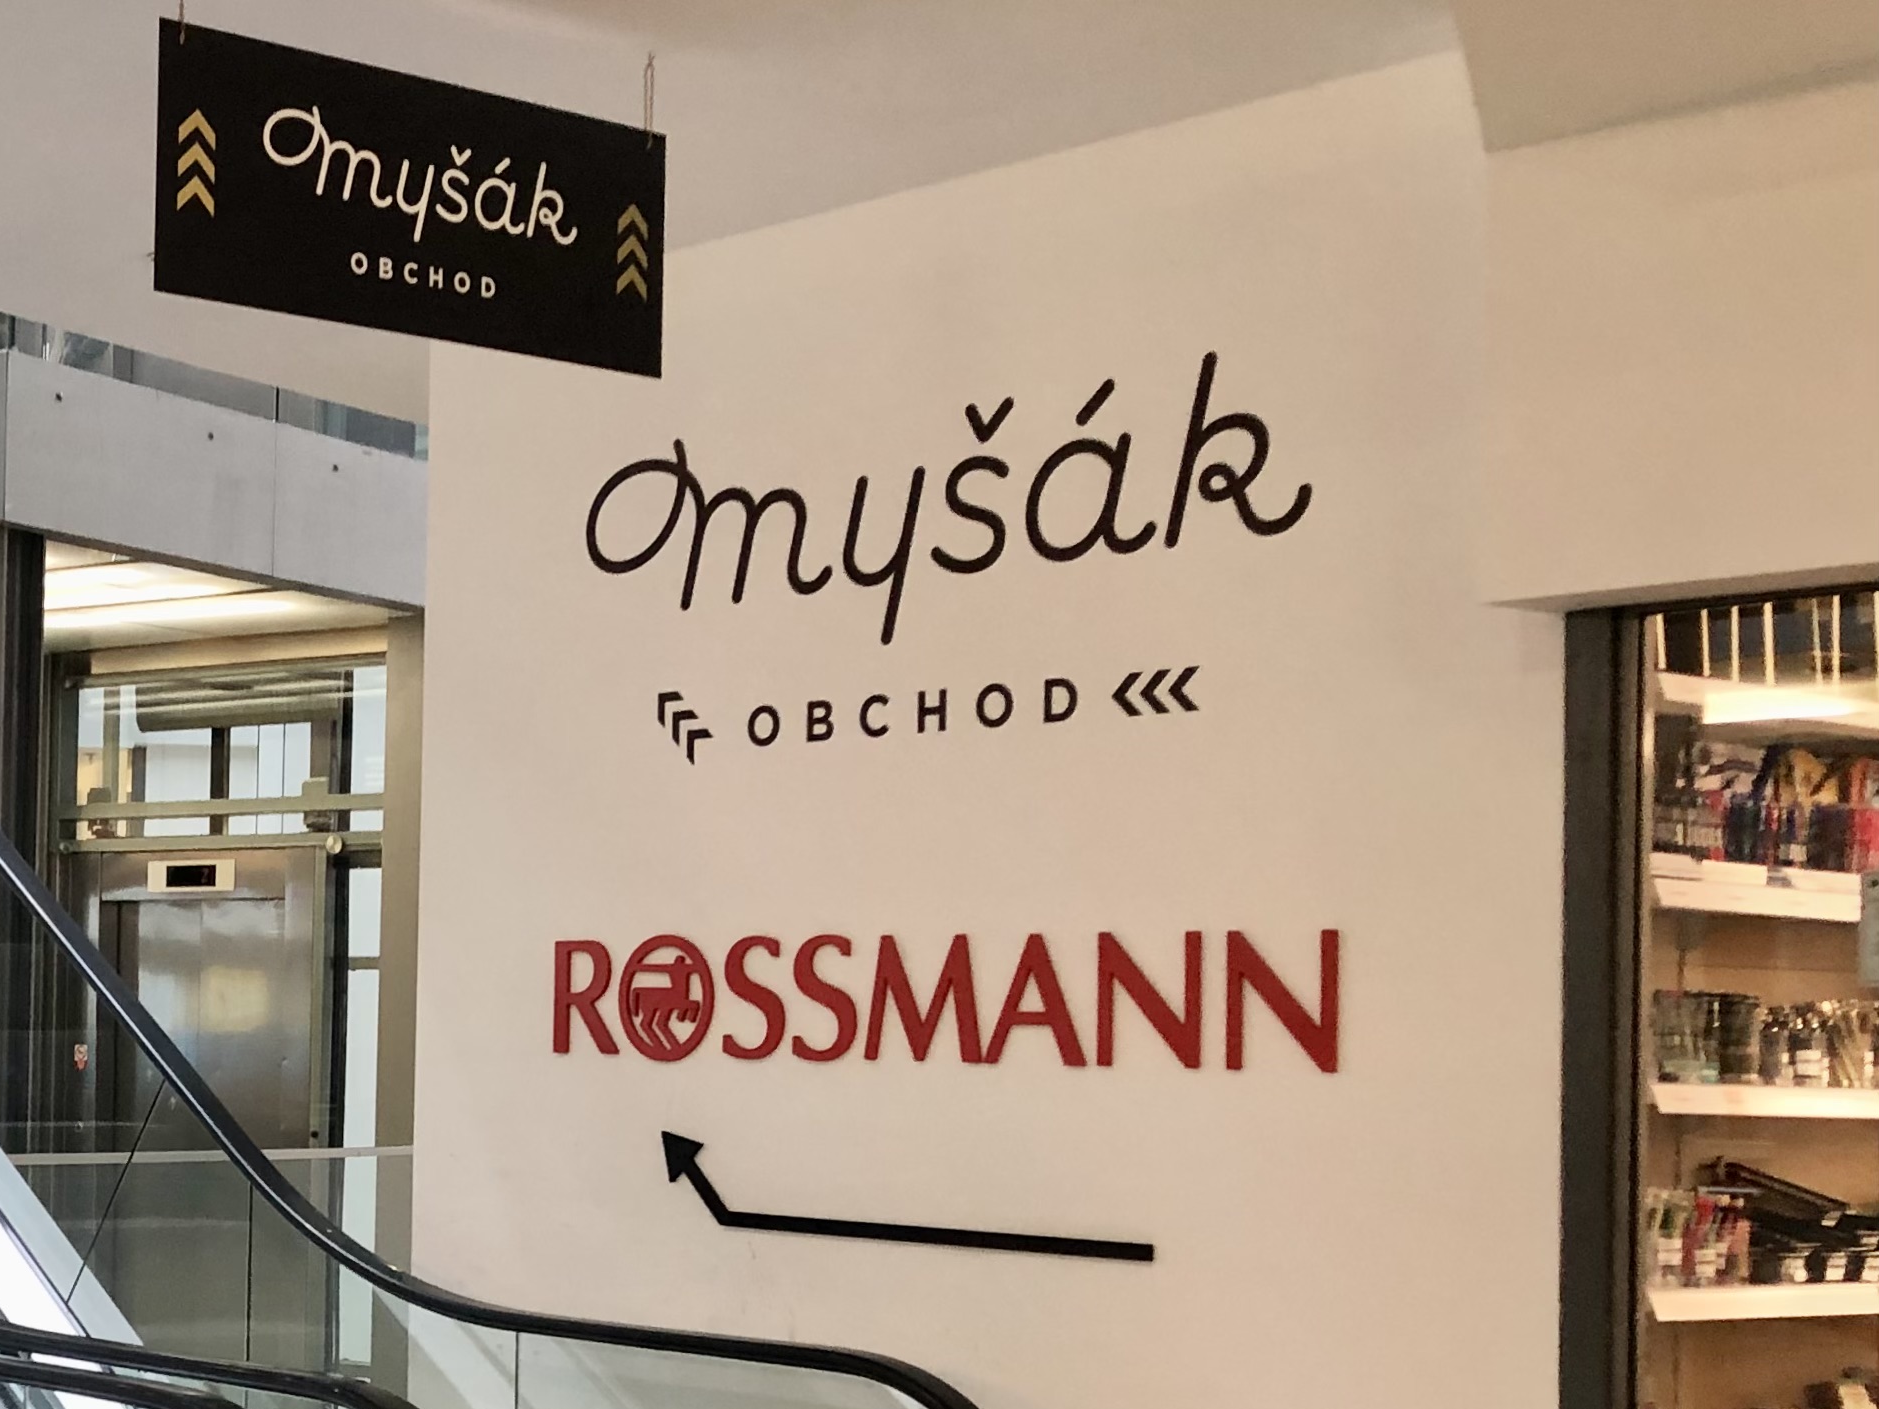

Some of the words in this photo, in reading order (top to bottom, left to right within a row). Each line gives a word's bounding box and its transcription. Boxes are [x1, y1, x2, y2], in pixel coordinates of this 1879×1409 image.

[350, 251, 496, 299] OBCHOD
[746, 676, 1079, 747] OBCHOD
[552, 928, 1340, 1074] ROSSMANN
